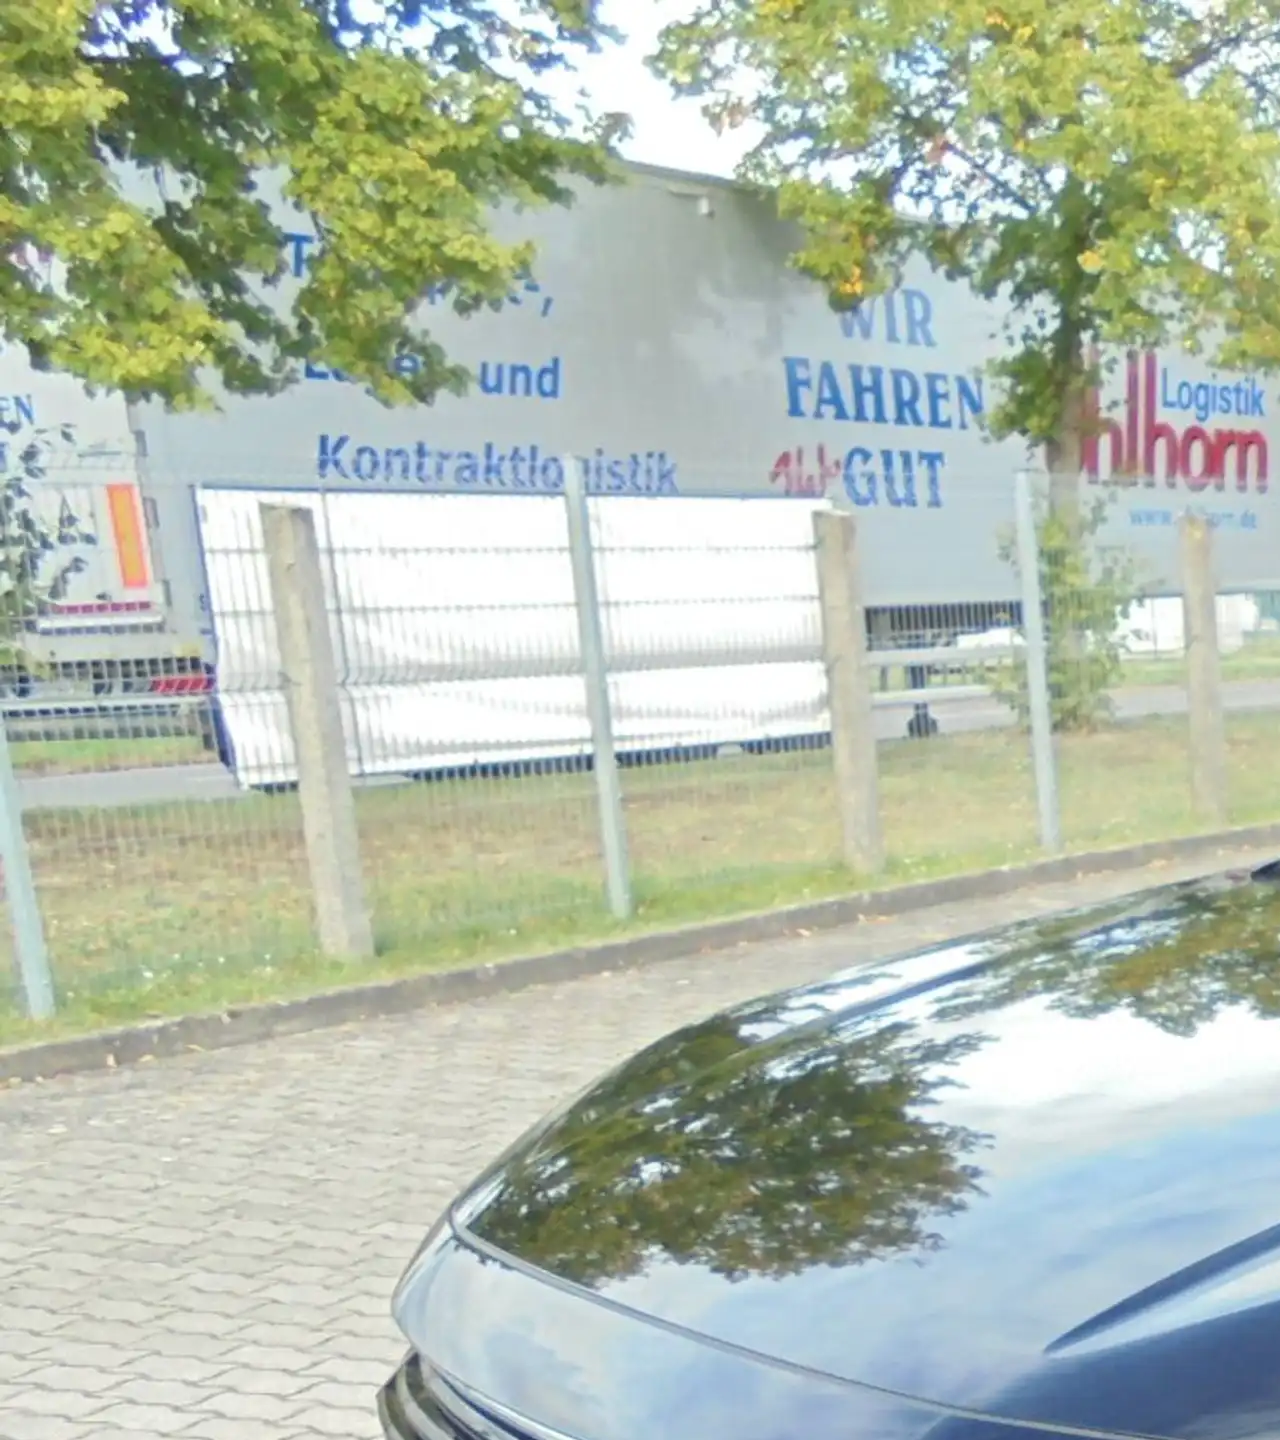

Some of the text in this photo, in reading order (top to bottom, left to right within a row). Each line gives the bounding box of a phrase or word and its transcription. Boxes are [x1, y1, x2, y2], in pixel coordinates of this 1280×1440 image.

[840, 288, 937, 348] WIR
[480, 356, 561, 399] und
[782, 356, 984, 430] FAHREN
[1161, 366, 1265, 423] Logistik
[1081, 345, 1269, 494] hlhorn
[317, 433, 680, 494] Kontraktloistik
[842, 446, 946, 508] GUT
